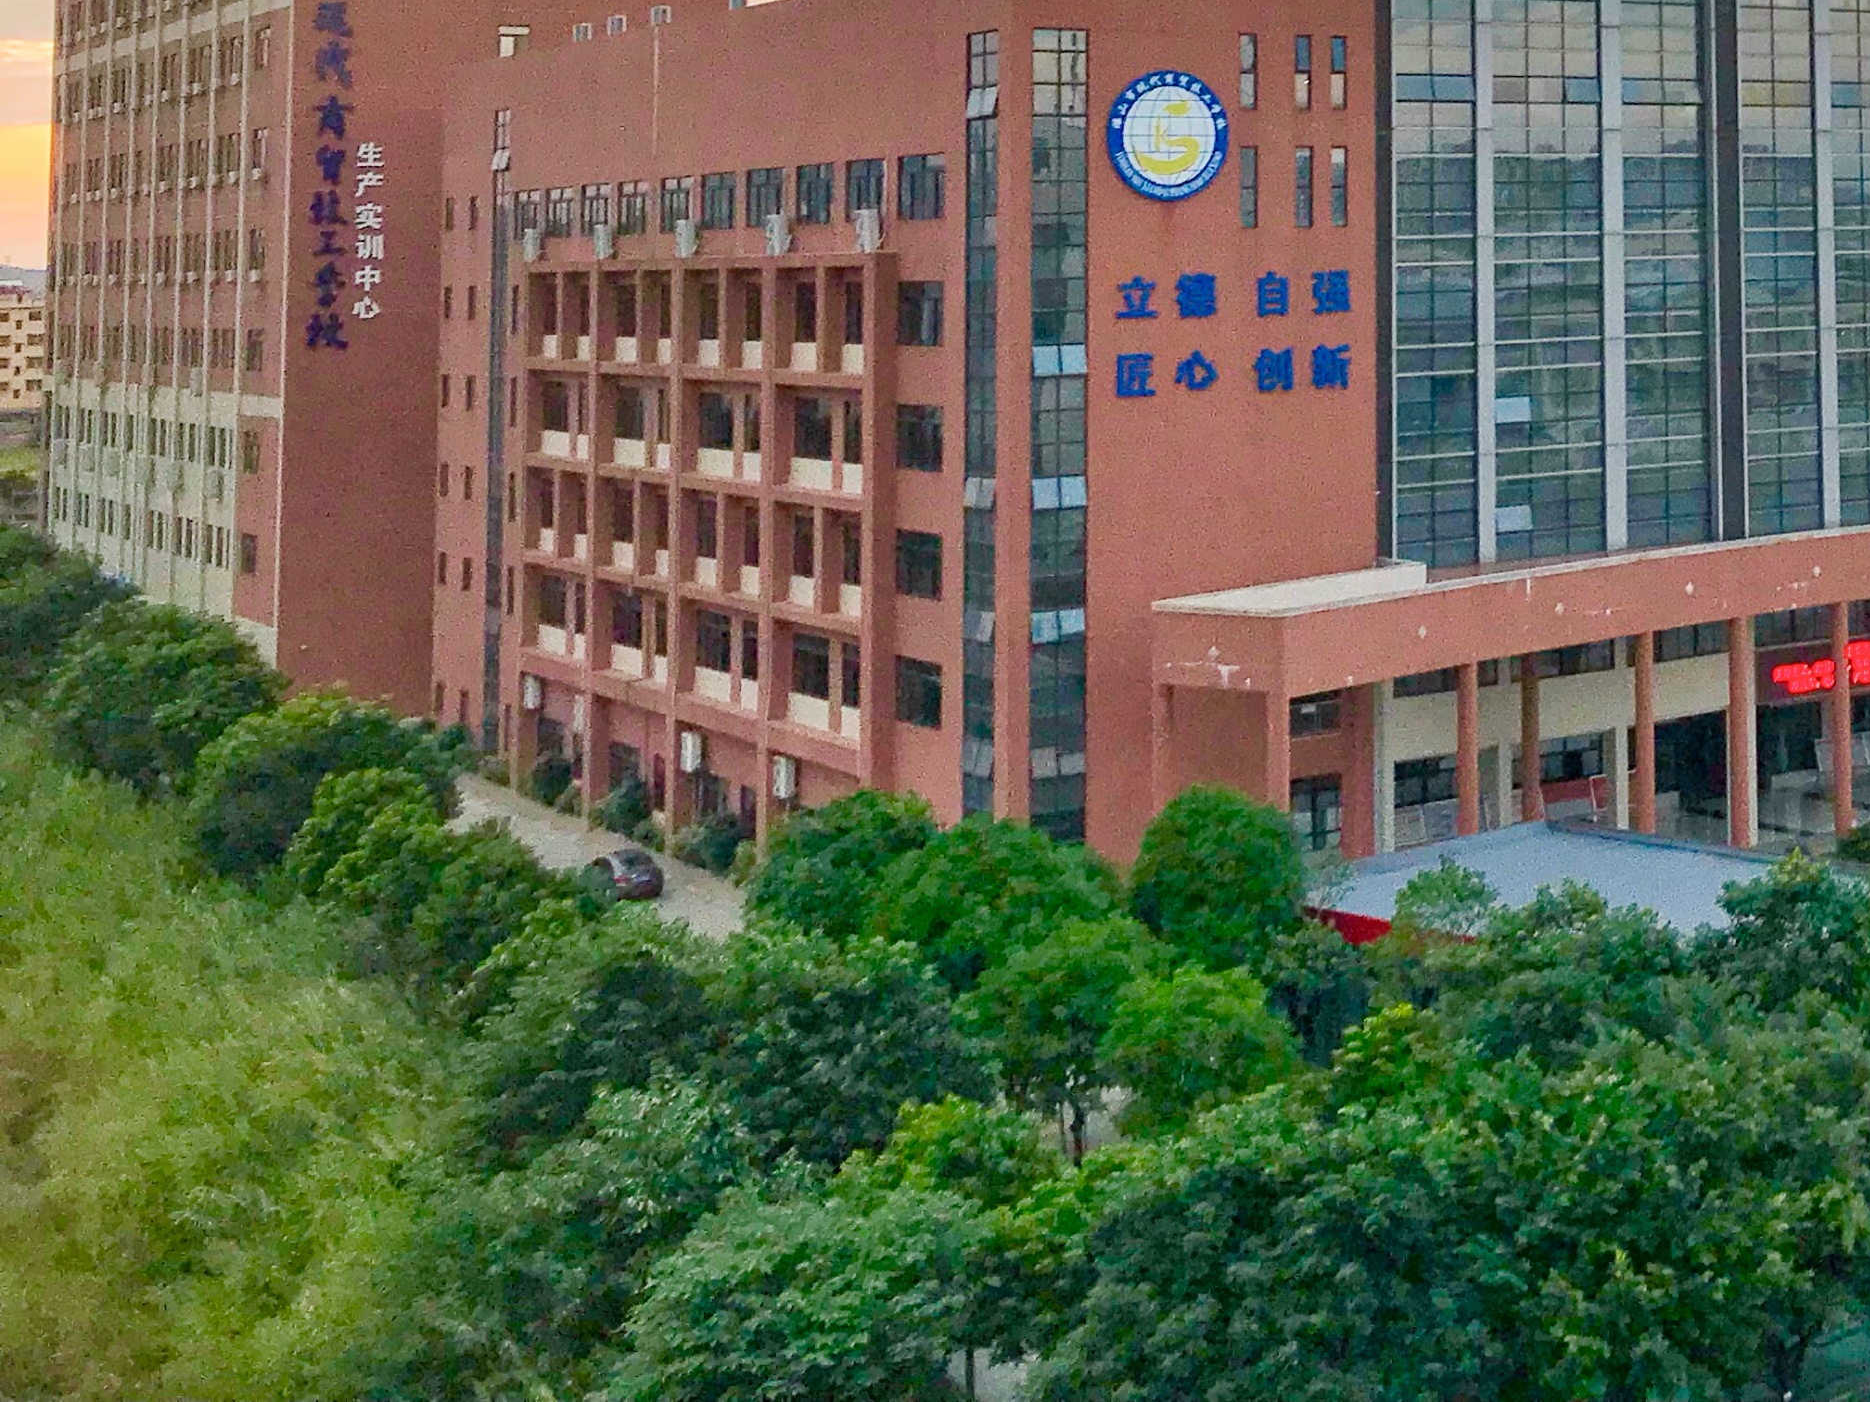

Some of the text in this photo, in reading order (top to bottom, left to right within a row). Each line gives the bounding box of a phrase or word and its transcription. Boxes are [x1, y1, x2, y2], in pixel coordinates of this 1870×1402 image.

[352, 142, 384, 320] 生产实训中心
[1116, 270, 1352, 320] 立德 自强
[1116, 343, 1352, 398] 匠心 创新
